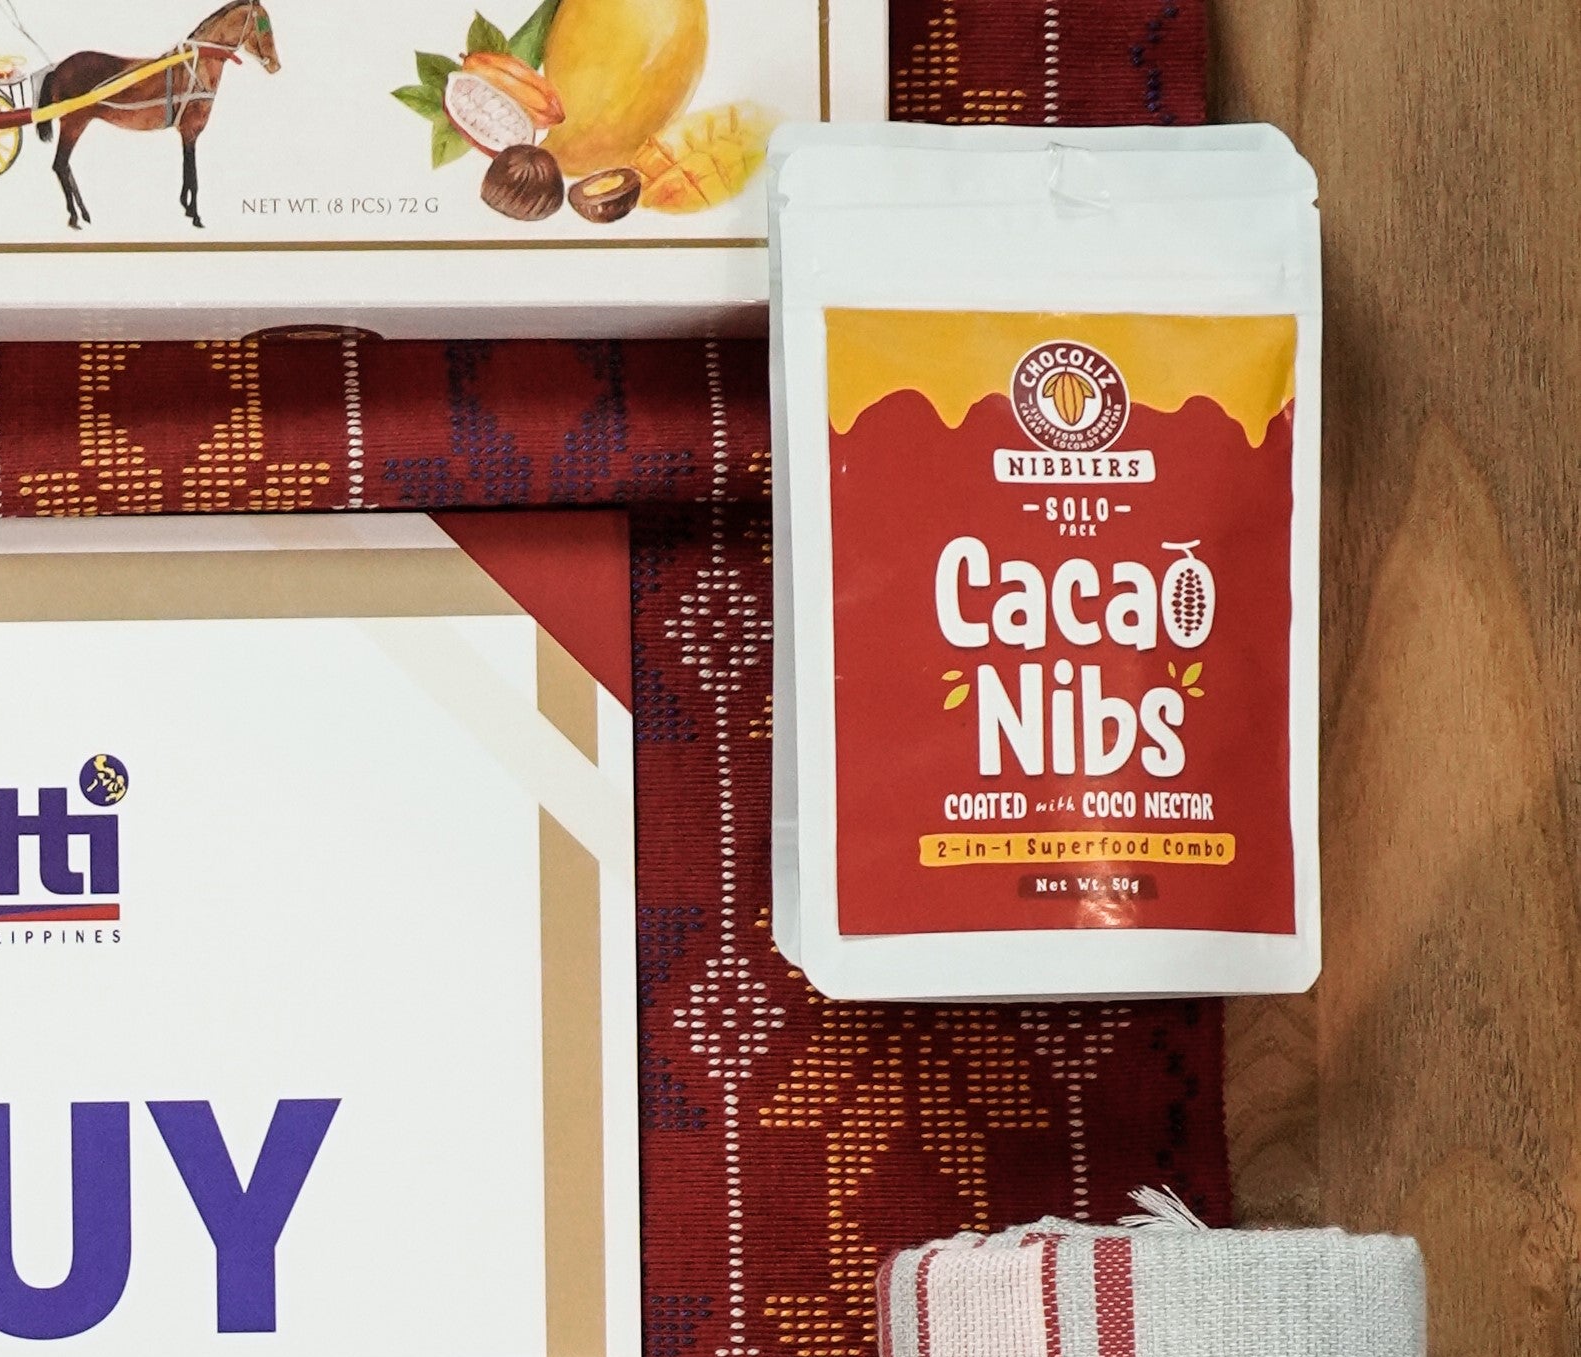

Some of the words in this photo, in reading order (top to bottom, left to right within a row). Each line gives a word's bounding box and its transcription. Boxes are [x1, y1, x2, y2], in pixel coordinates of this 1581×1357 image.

[242, 198, 281, 214] NET
[288, 198, 321, 214] WT.
[327, 198, 344, 216] (8
[351, 197, 392, 216] PCS)
[399, 198, 418, 213] 72
[424, 197, 439, 213] G
[1020, 347, 1118, 389] CHOCOLIZ
[1019, 402, 1042, 434] CACAO
[1052, 436, 1099, 450] COCONUT
[1100, 404, 1122, 439] NECTAR
[1030, 407, 1084, 441] SUPERFOOD
[1086, 409, 1112, 438] COMBO
[1008, 457, 1140, 477] NIBBLERS
[1059, 523, 1097, 536] PACK
[935, 536, 1216, 652] Cacao
[977, 658, 1187, 779] Nibs
[944, 793, 1028, 821] COATED
[1035, 797, 1076, 813] with
[1082, 791, 1136, 819] COCO
[1144, 793, 1215, 820] NECTAR
[937, 839, 1012, 858] 2-in-1
[1027, 838, 1150, 859] Superfood
[1162, 838, 1225, 857] Combo
[1035, 878, 1068, 893] Net
[1076, 878, 1107, 893] Wt.
[1111, 878, 1140, 894] 50g
